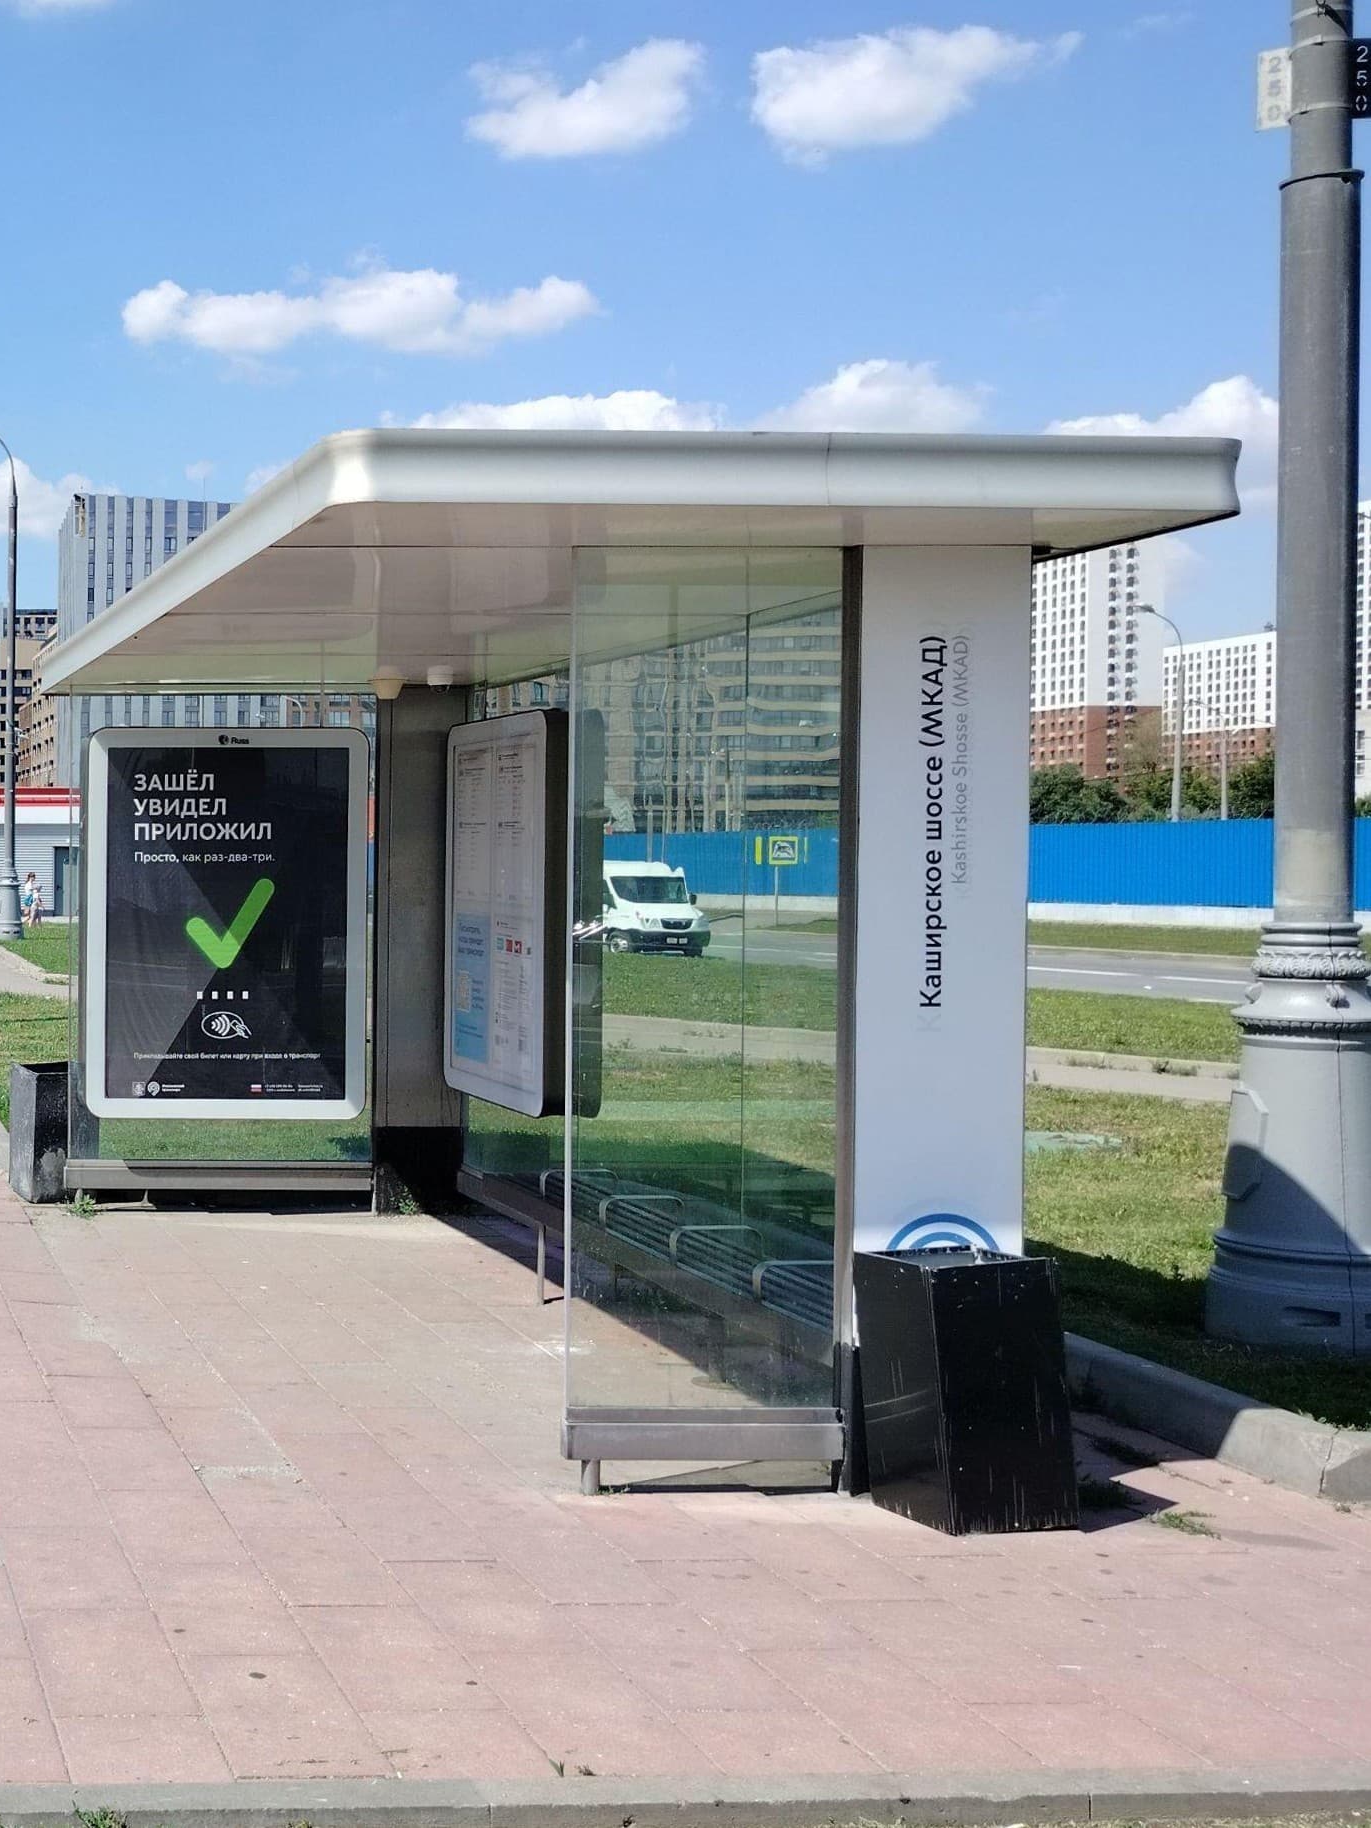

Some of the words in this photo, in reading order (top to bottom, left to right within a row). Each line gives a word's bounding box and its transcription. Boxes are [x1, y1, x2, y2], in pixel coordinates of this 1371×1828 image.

[1356, 45, 1369, 111] 250
[919, 636, 948, 747] (МКАД)
[951, 636, 970, 707] (MKAD)
[951, 713, 968, 777] Shosse
[133, 769, 215, 791] ЗАШЁЛ
[133, 798, 227, 818] УВИДЕЛ
[926, 756, 943, 840] шоссе
[134, 822, 272, 841] ПРИЛОЖИЛ
[134, 852, 180, 864] Просто,
[182, 853, 201, 862] как
[204, 853, 276, 864] раз-два-три.
[951, 782, 967, 884] Kashirskoe
[920, 850, 947, 1007] Каширское
